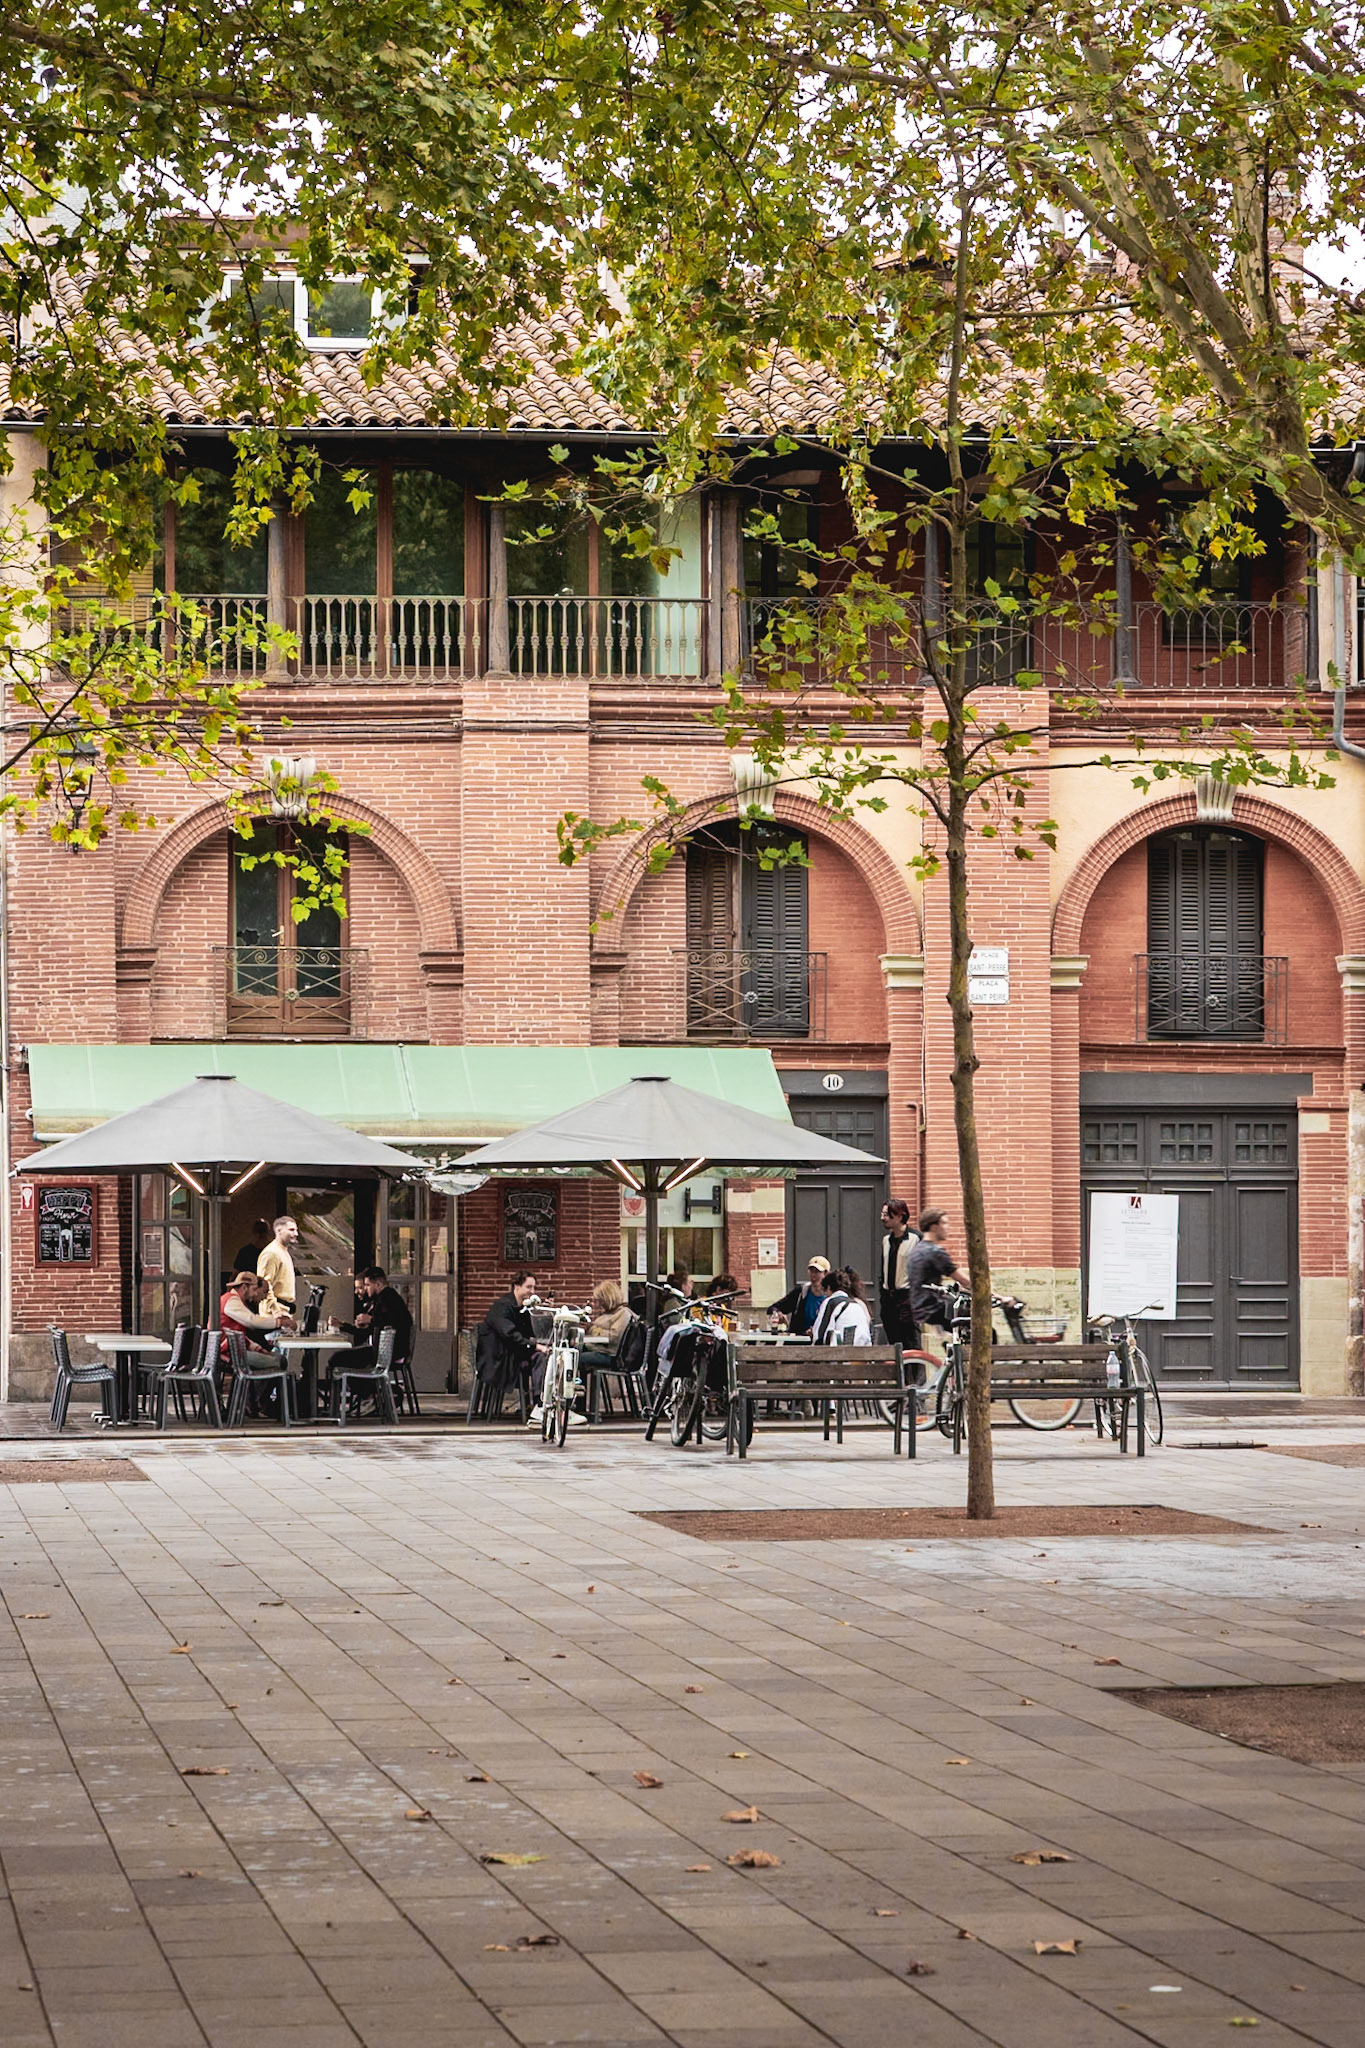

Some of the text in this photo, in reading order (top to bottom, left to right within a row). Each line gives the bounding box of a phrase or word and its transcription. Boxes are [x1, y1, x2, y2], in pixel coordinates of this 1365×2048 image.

[970, 963, 1006, 971] SAINT-PIERRE
[828, 1076, 839, 1088] 10
[47, 1194, 84, 1207] HAPPY
